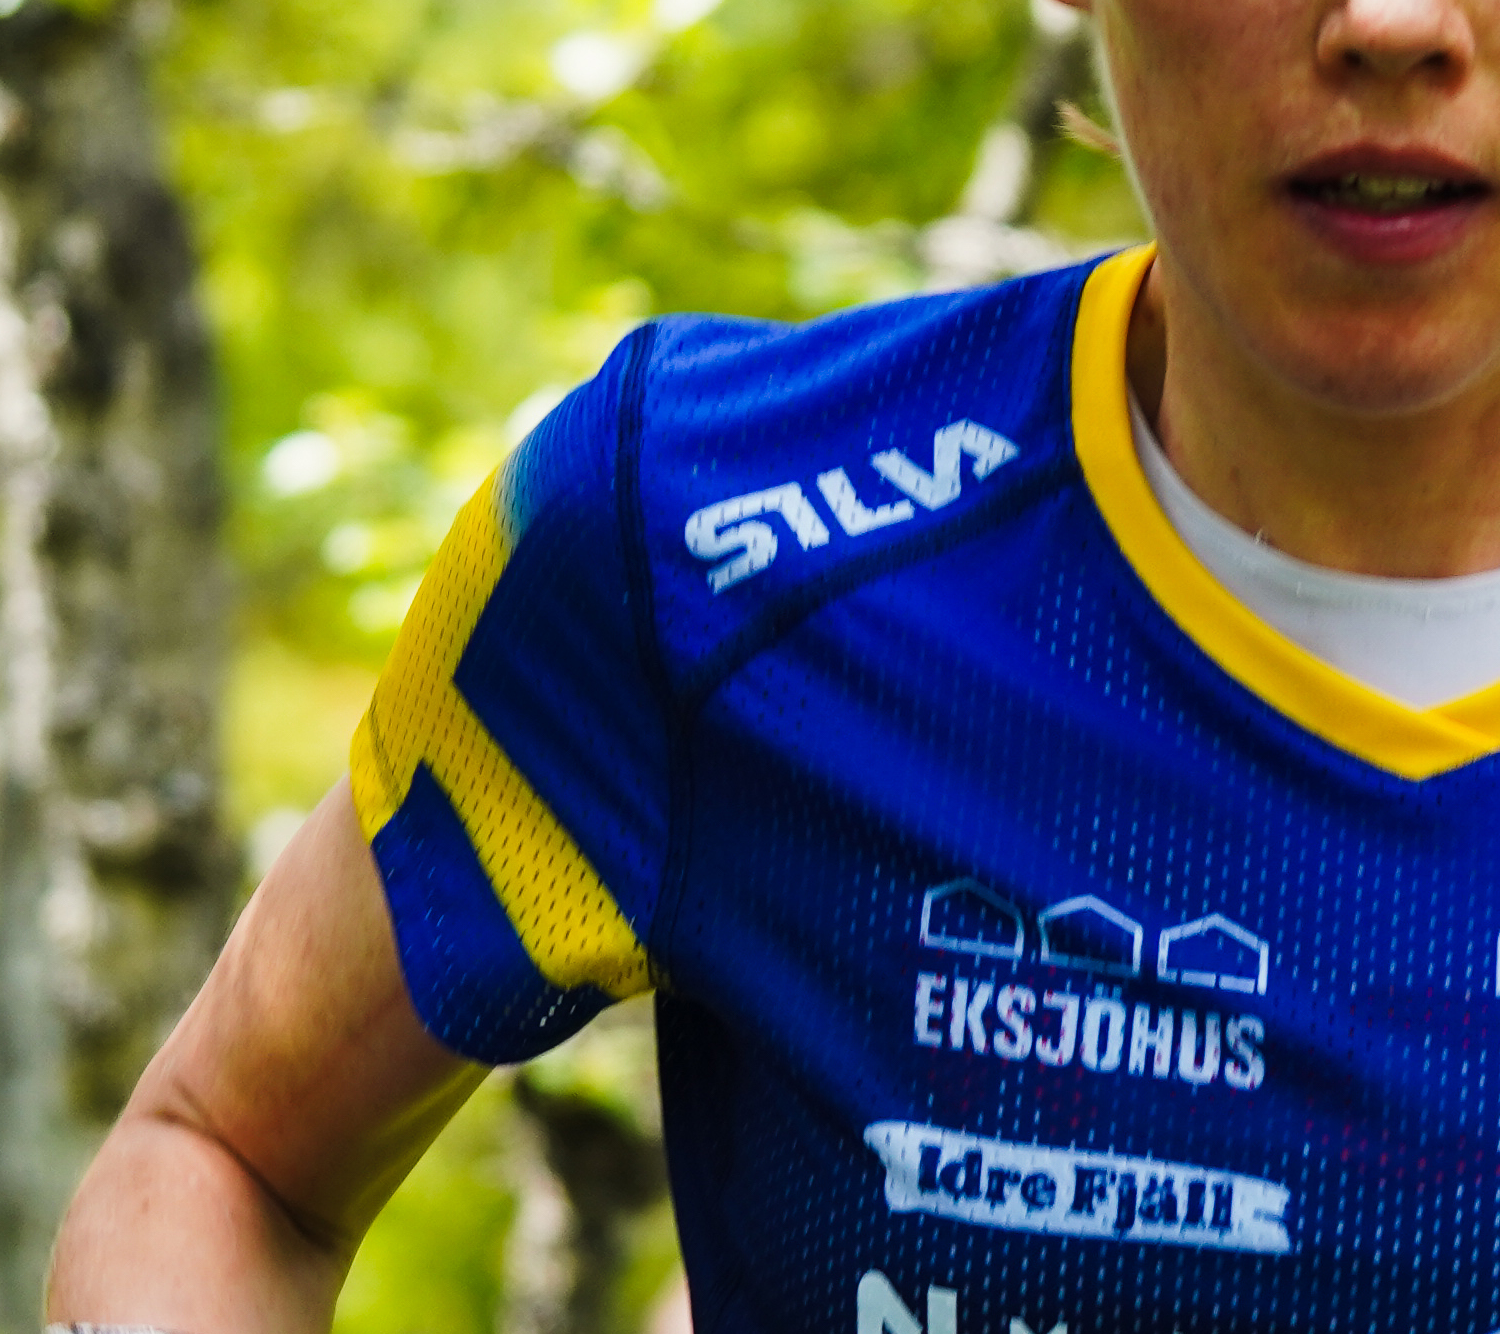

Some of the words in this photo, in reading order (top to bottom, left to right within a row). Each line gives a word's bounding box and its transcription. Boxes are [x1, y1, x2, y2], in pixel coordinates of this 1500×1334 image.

[684, 417, 1021, 595] SILVA
[918, 1144, 1058, 1210] Idre
[1068, 1168, 1234, 1230] Fjäll
